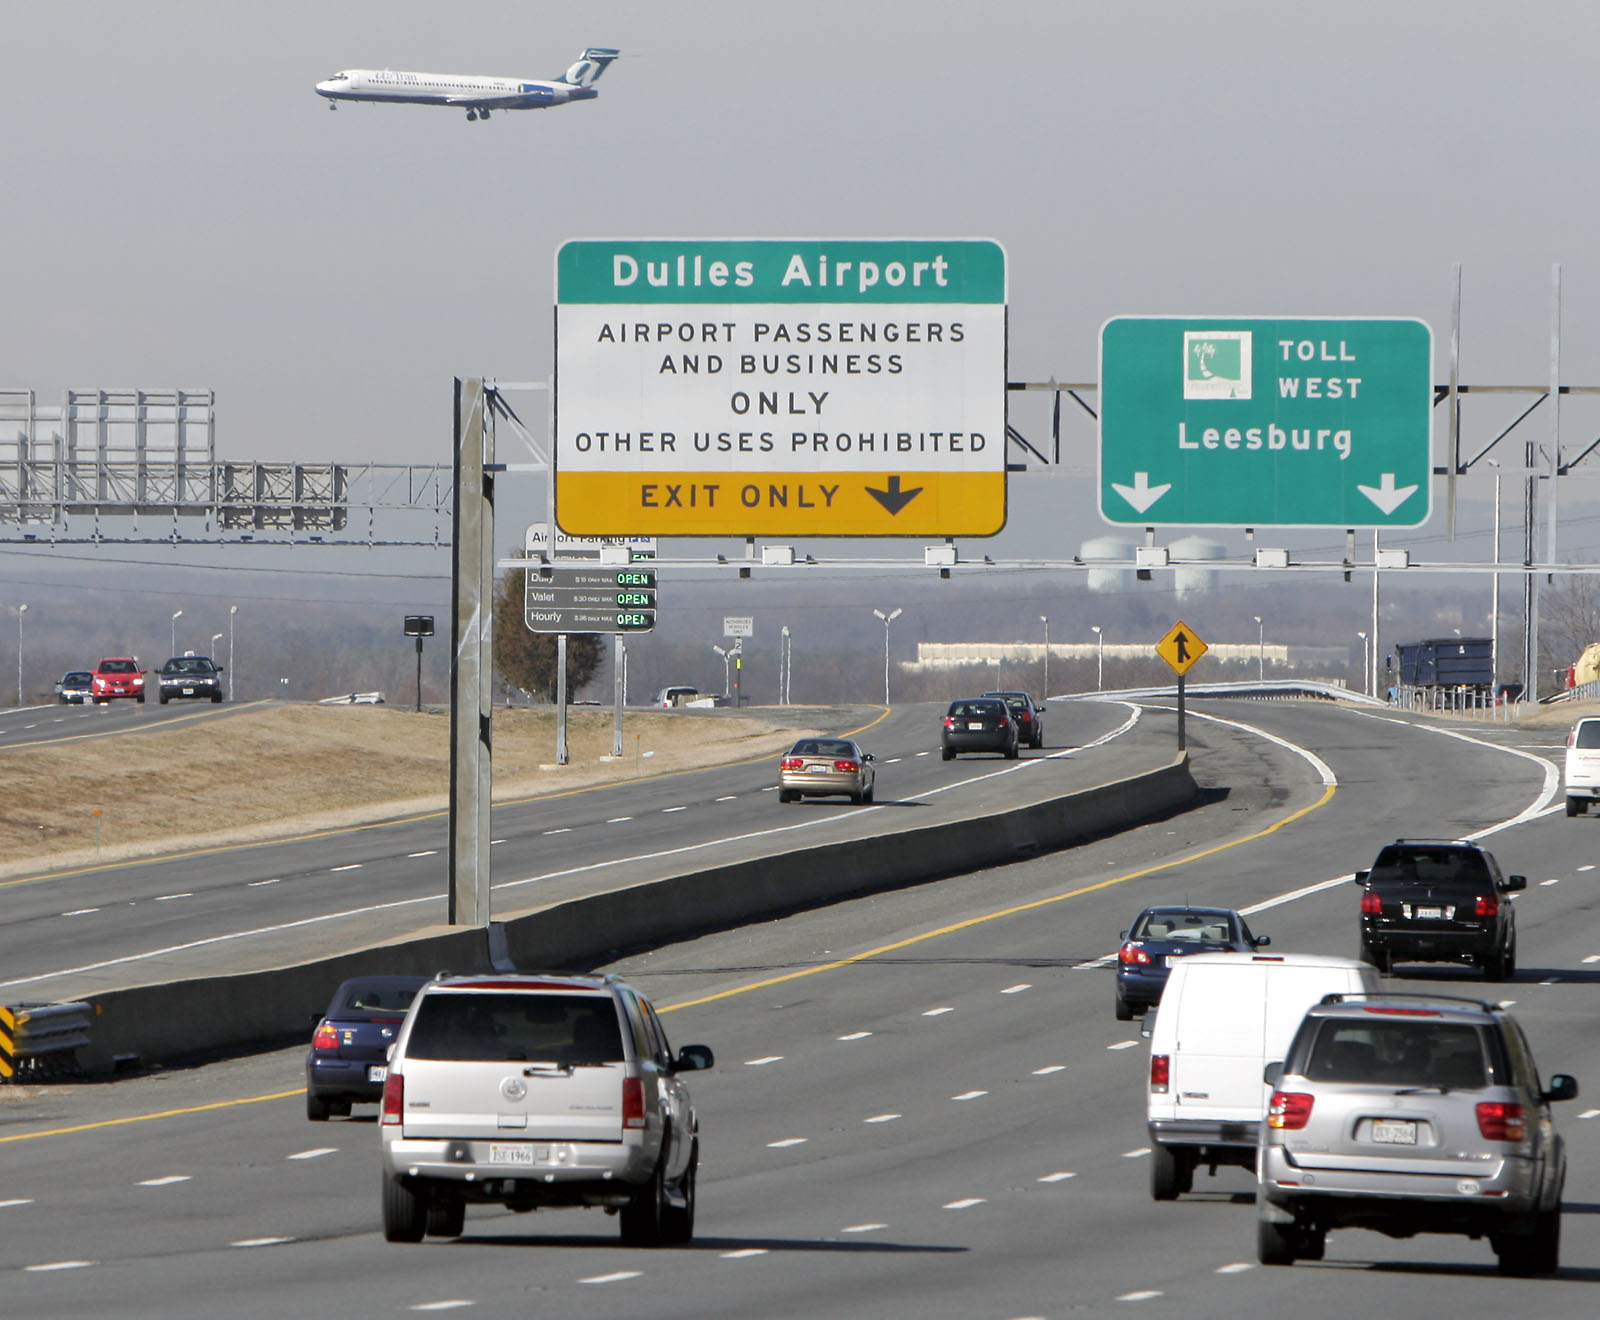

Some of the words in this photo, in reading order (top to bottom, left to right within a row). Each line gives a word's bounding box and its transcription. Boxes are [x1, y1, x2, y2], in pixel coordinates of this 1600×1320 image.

[613, 254, 755, 287] Dulles
[780, 253, 949, 293] Airport
[597, 322, 736, 343] AIRPORT
[754, 322, 964, 343] PASSENGERS
[1278, 339, 1356, 362] TOLL
[659, 354, 723, 374] AND
[740, 354, 903, 375] BUSINESS
[1278, 377, 1362, 399] WEST
[730, 391, 829, 415] ONLY
[575, 432, 676, 452] OTHER
[694, 432, 774, 452] USES
[791, 432, 986, 452] PROHIBITED
[1178, 422, 1352, 460] Leesburg
[641, 484, 720, 507] EXIT
[741, 484, 839, 508] ONLY
[532, 532, 575, 543] Airort
[617, 573, 648, 585] OPEN
[531, 592, 555, 602] Valet
[617, 593, 649, 605] OPEN
[531, 611, 562, 623] Hourly
